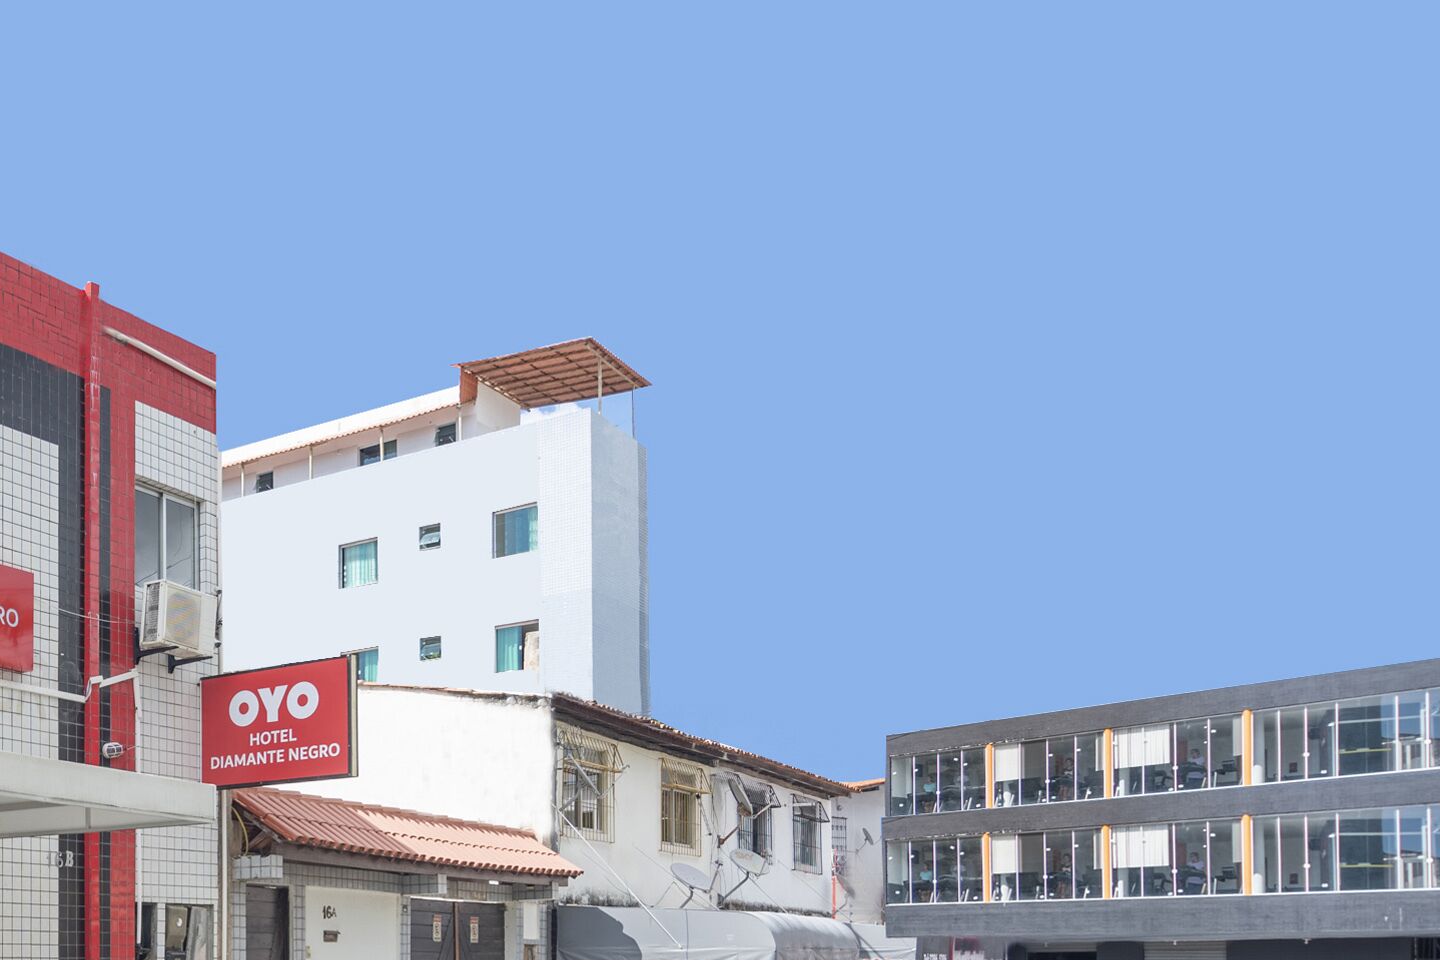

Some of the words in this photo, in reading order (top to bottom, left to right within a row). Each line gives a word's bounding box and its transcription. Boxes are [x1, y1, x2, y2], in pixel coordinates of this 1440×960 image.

[228, 681, 320, 727] OYO
[249, 728, 298, 747] HOTEL
[210, 748, 286, 770] DIAMANTE
[288, 742, 341, 762] NEGRO
